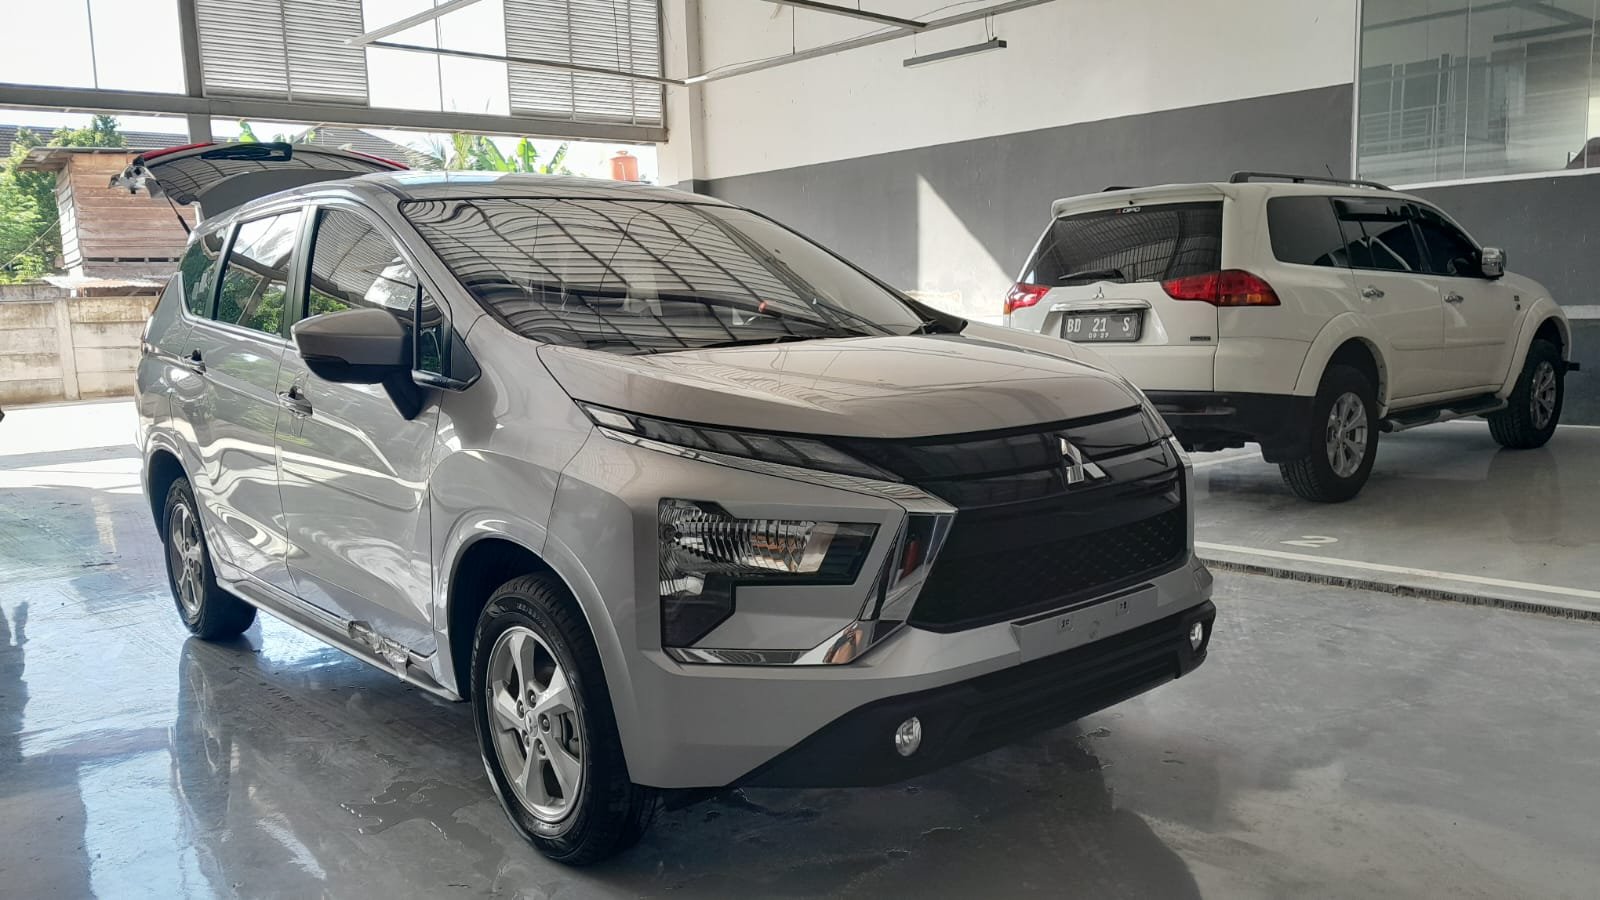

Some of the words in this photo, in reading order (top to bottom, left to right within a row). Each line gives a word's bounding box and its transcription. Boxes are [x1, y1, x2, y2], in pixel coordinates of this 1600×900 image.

[1067, 318, 1081, 333] BD
[1092, 318, 1107, 332] 21
[1122, 317, 1130, 332] S
[1280, 535, 1338, 548] 2
